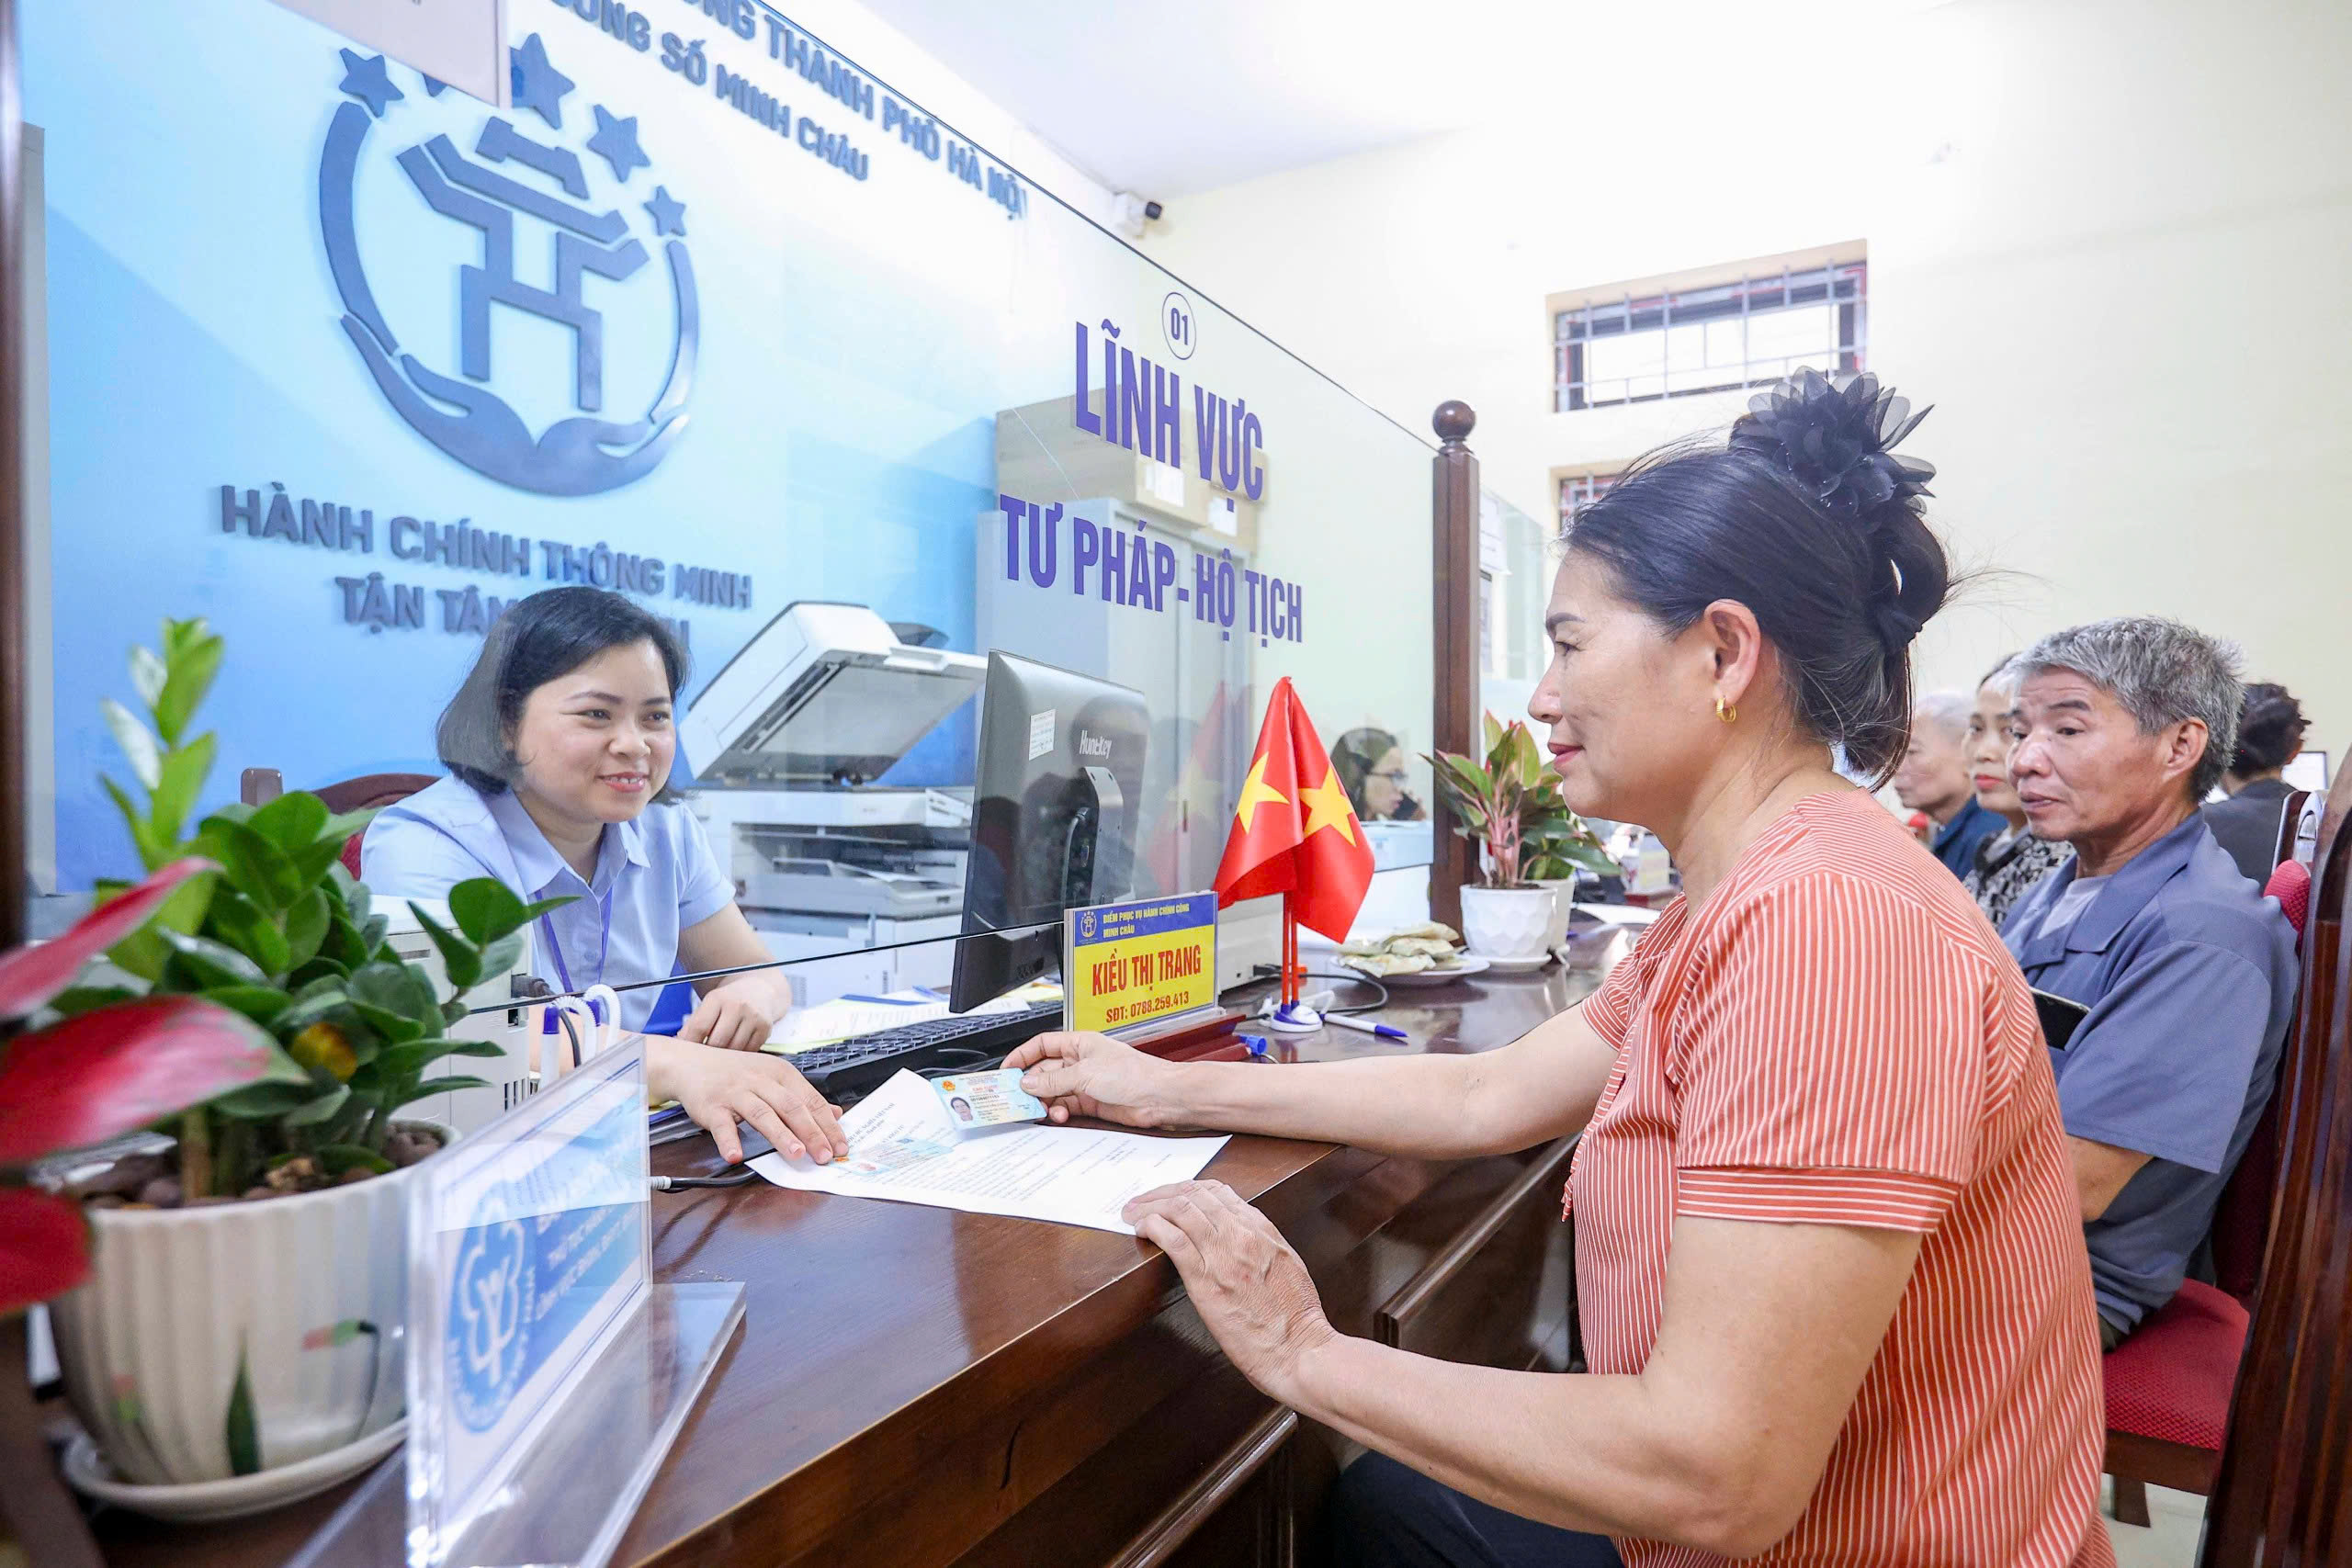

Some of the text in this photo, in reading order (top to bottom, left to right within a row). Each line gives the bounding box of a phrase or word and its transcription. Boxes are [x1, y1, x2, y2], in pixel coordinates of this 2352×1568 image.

[661, 31, 707, 86] SỐ
[716, 63, 791, 138] MINH
[797, 117, 869, 181] CHÂU
[947, 140, 983, 191] HÀ
[1170, 307, 1189, 346] 01
[1075, 318, 1263, 513] LĨNH VỰC
[220, 480, 753, 609] HÀNH CHÍNH THÔNG MINH
[1000, 493, 1064, 589] TƯ
[1244, 569, 1303, 649] TỊCH
[334, 571, 424, 634] TẬN
[1102, 927, 1119, 939] MINH
[1091, 944, 1202, 997] KIỀU THỊ TRANG
[1105, 1007, 1129, 1024] SĐT:
